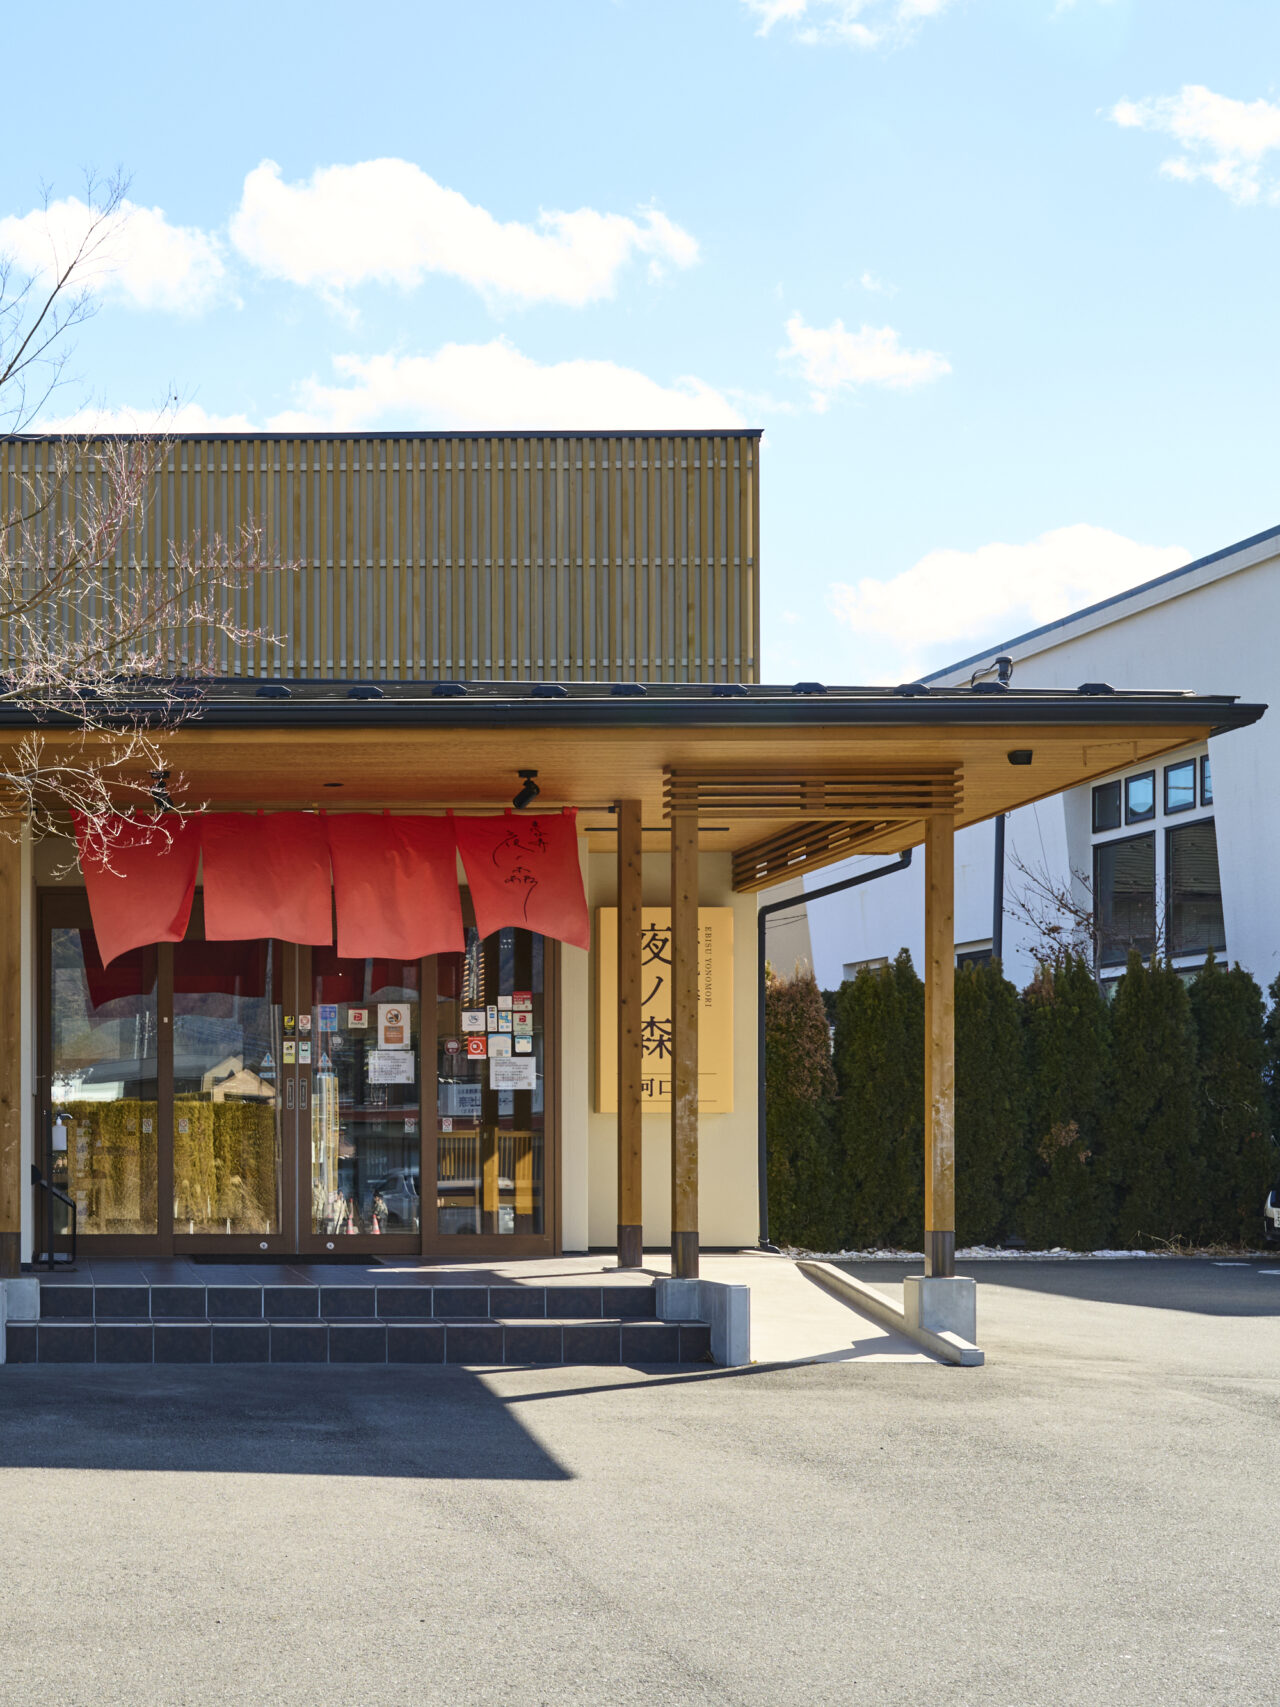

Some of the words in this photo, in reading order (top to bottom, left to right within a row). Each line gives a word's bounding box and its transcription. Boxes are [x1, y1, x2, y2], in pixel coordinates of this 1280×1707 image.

[704, 926, 713, 955] EBISU
[641, 923, 672, 1059] 夜ノ森
[704, 957, 713, 1008] YONOMORI
